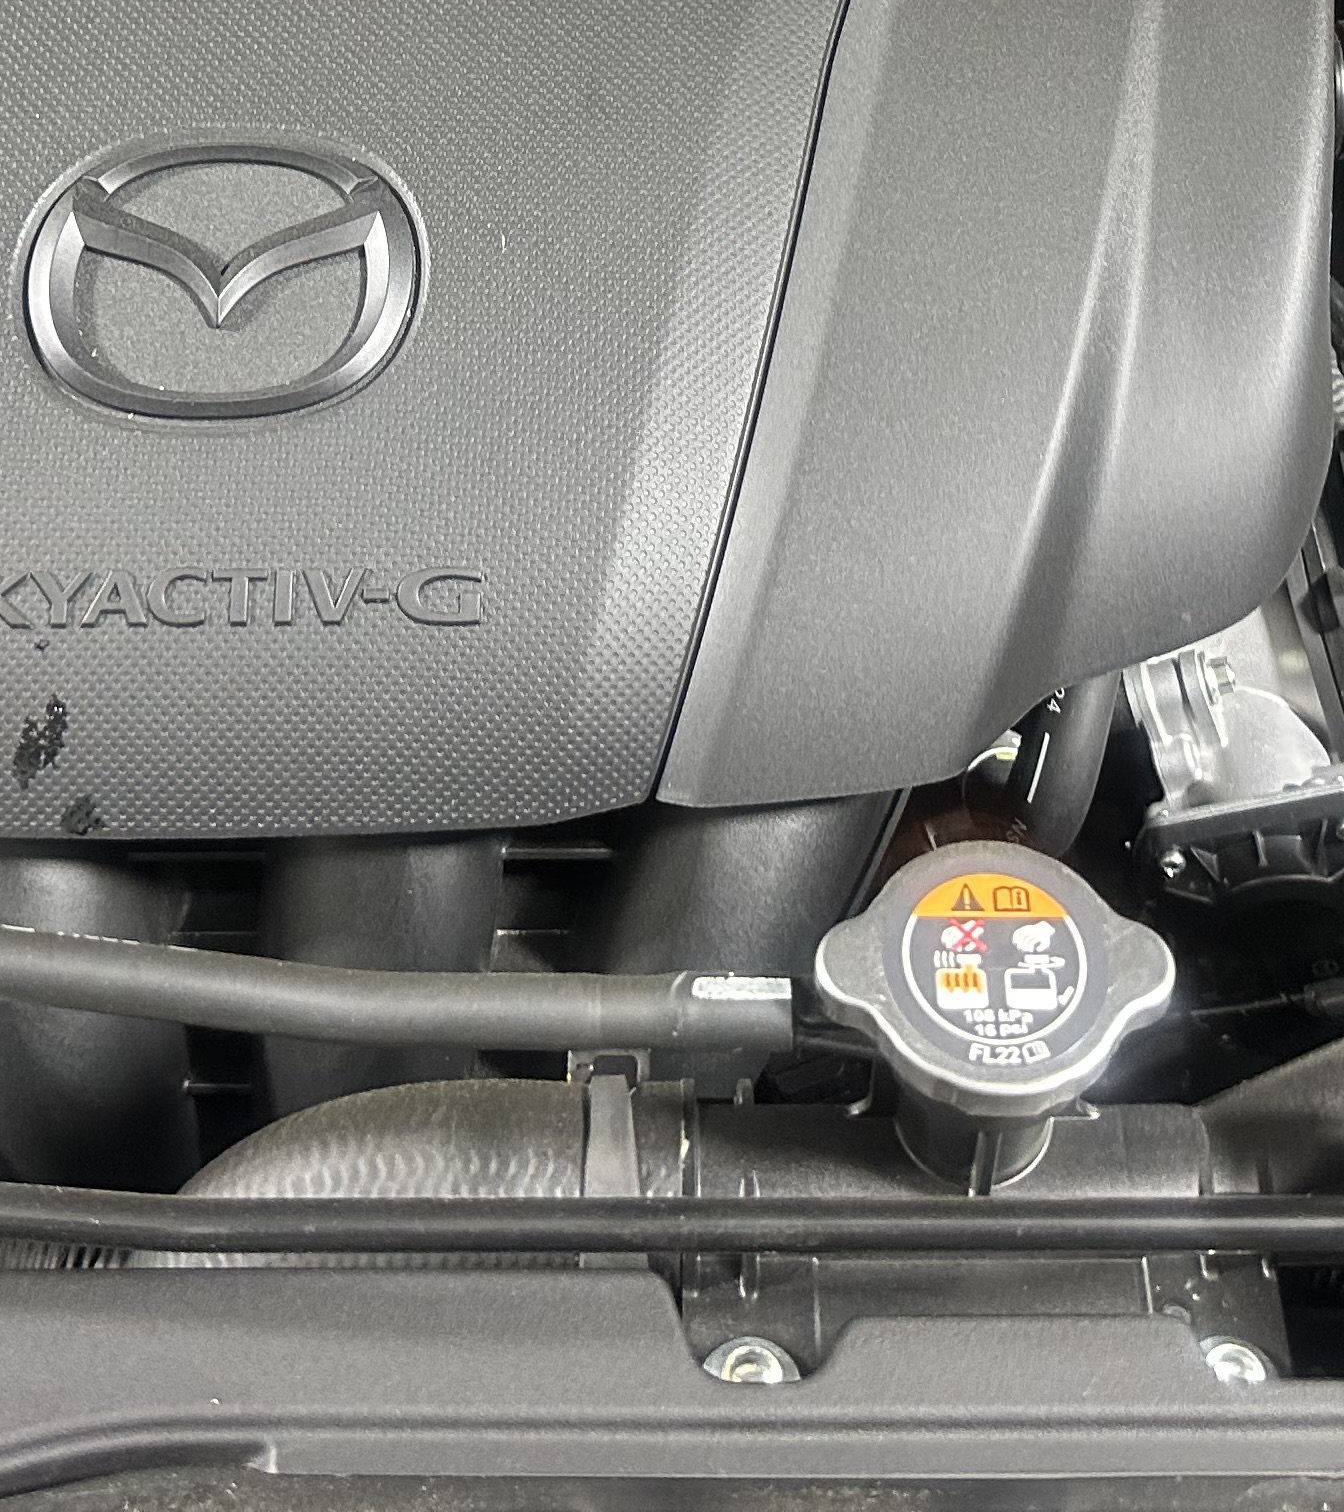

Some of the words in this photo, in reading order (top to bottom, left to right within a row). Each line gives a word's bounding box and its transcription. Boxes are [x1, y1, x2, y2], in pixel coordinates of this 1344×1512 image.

[998, 1008, 1034, 1024] kPa
[974, 1024, 997, 1037] 16
[1000, 1024, 1029, 1037] psi
[969, 1043, 1022, 1064] FL22
